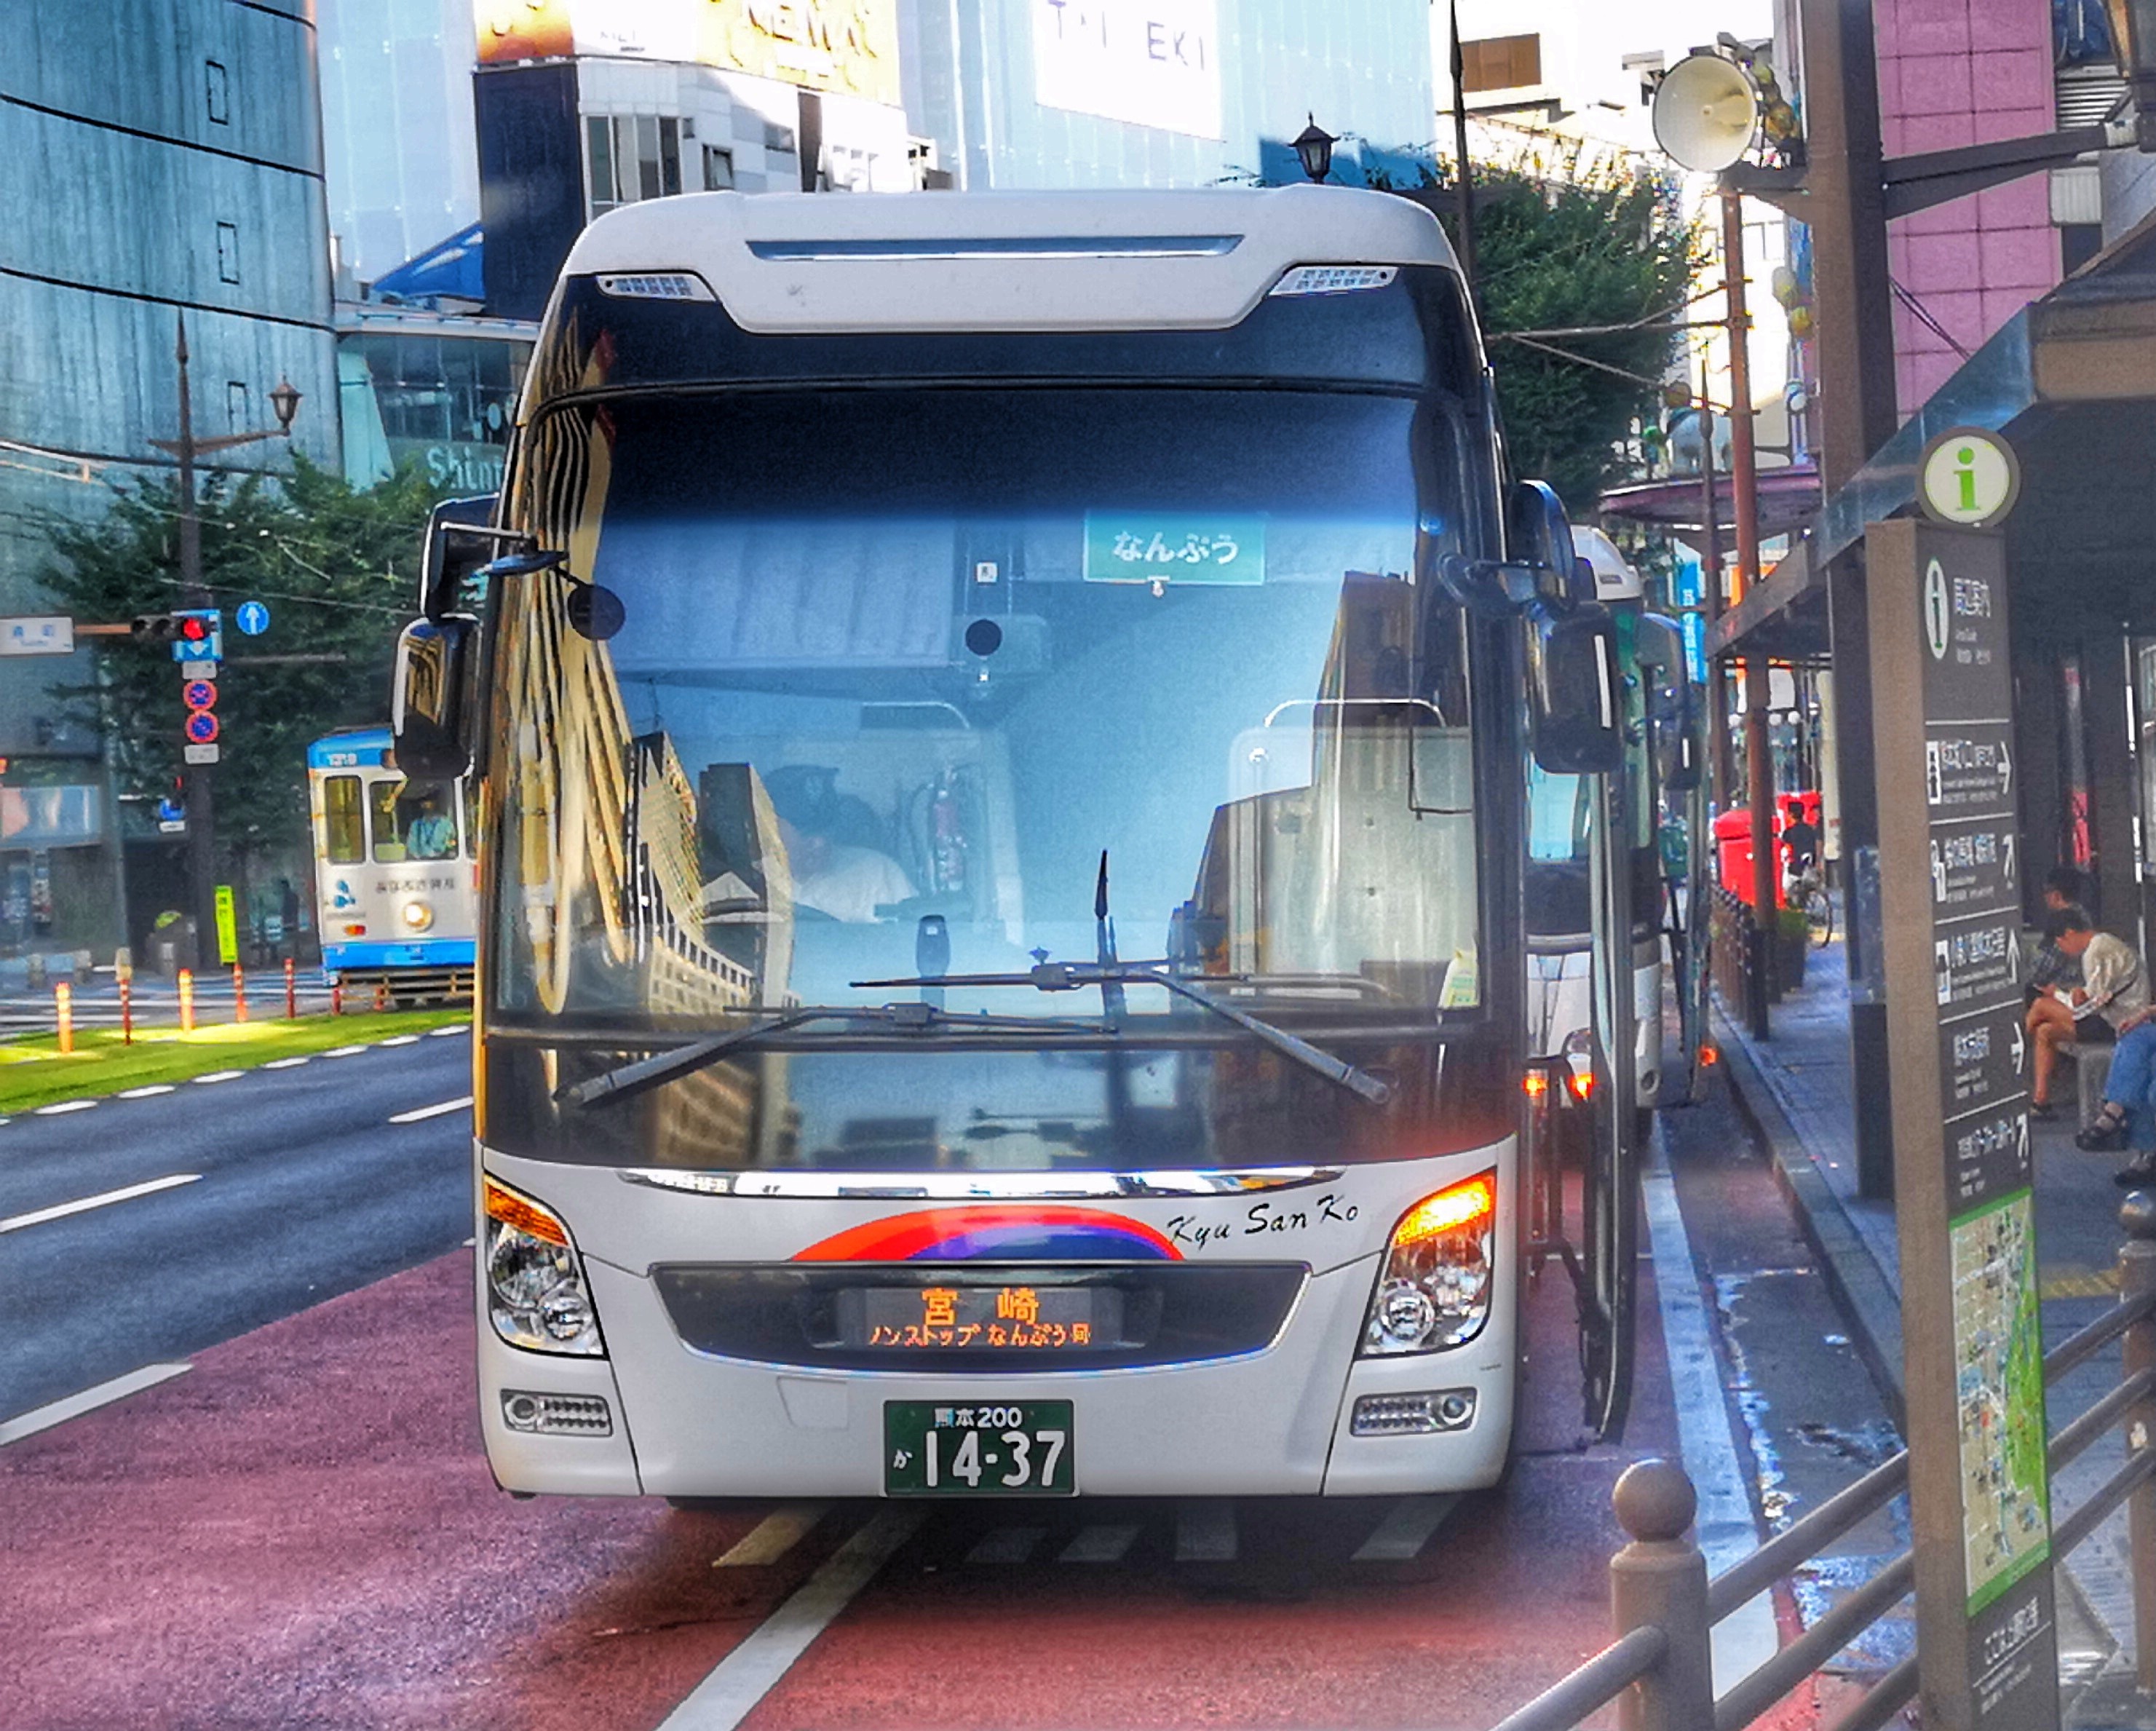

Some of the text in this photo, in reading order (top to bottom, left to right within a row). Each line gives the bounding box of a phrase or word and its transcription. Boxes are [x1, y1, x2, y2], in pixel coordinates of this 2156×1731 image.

[1954, 446, 1981, 511] i
[1167, 1194, 1358, 1251] Kyu San Ko
[893, 1449, 913, 1469] か
